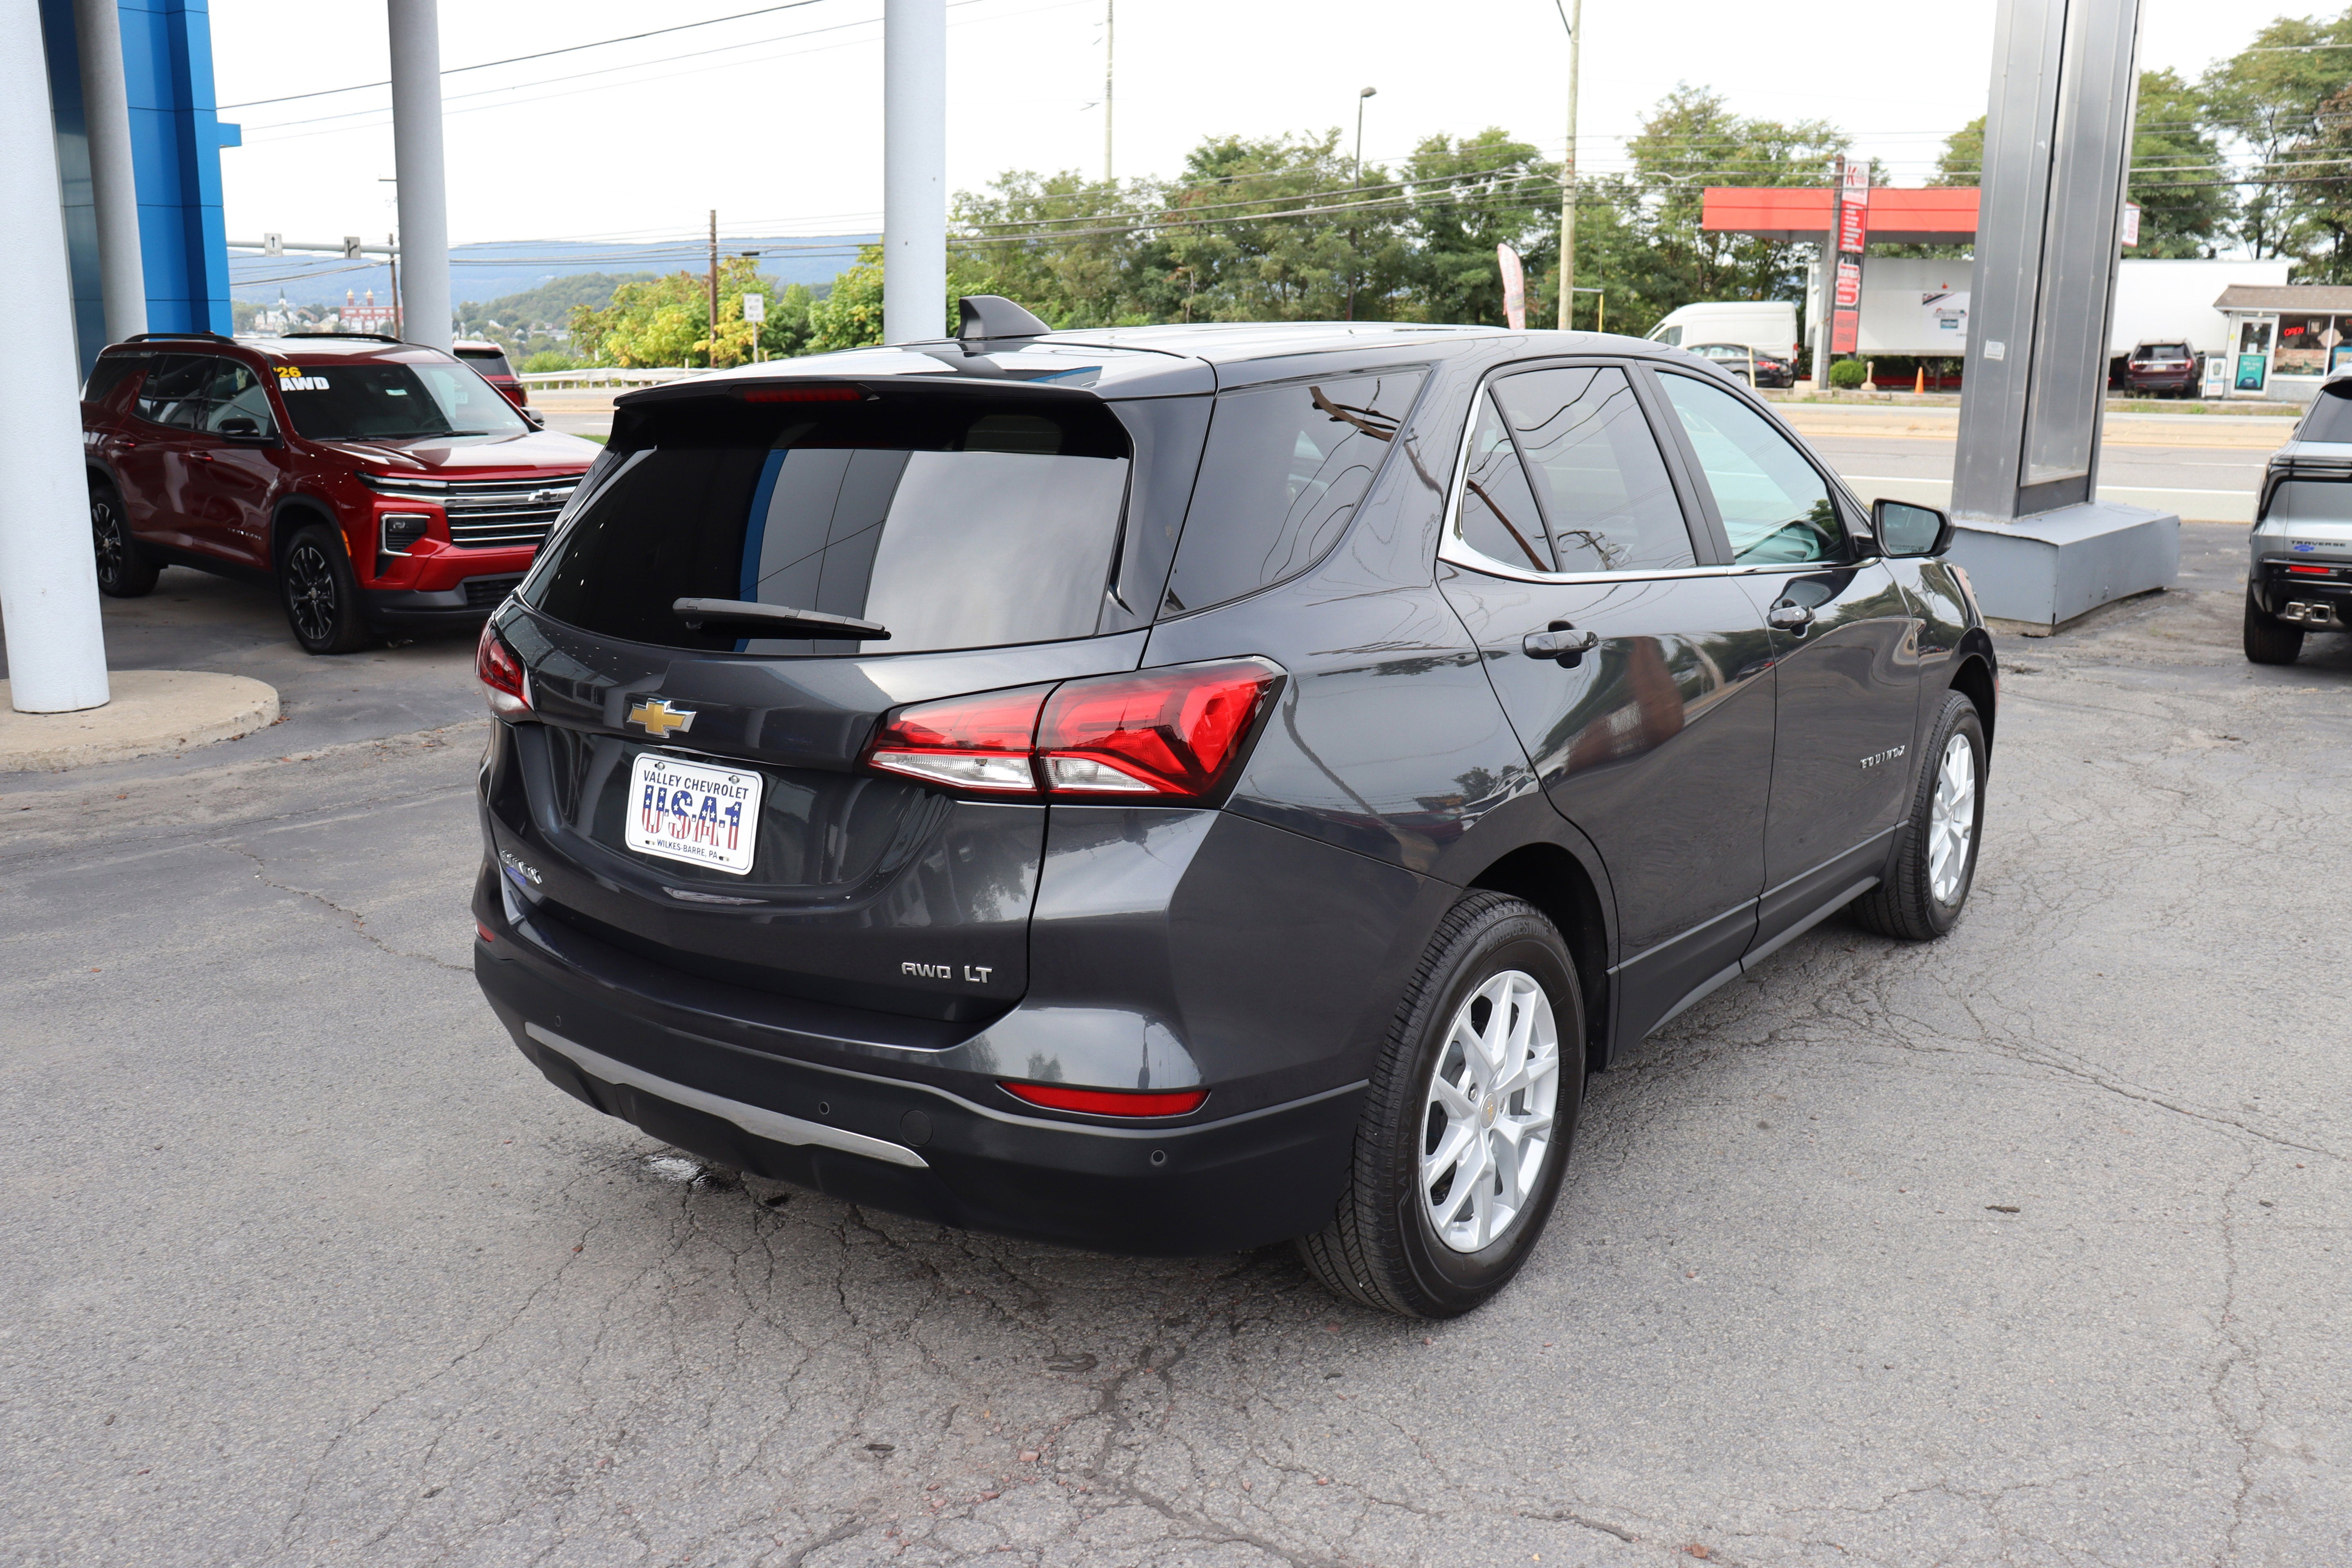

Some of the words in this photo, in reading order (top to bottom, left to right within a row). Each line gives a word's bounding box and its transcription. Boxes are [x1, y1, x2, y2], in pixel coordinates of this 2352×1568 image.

[2284, 326, 2305, 337] OPEN
[272, 366, 302, 378] '26
[279, 376, 330, 392] AWD
[644, 770, 682, 787] VALLEY
[684, 777, 749, 800] CHEVROLET
[657, 838, 707, 858] WILKES-BARRE,
[709, 850, 717, 859] PA
[901, 962, 952, 980] AWD
[964, 965, 993, 983] LT
